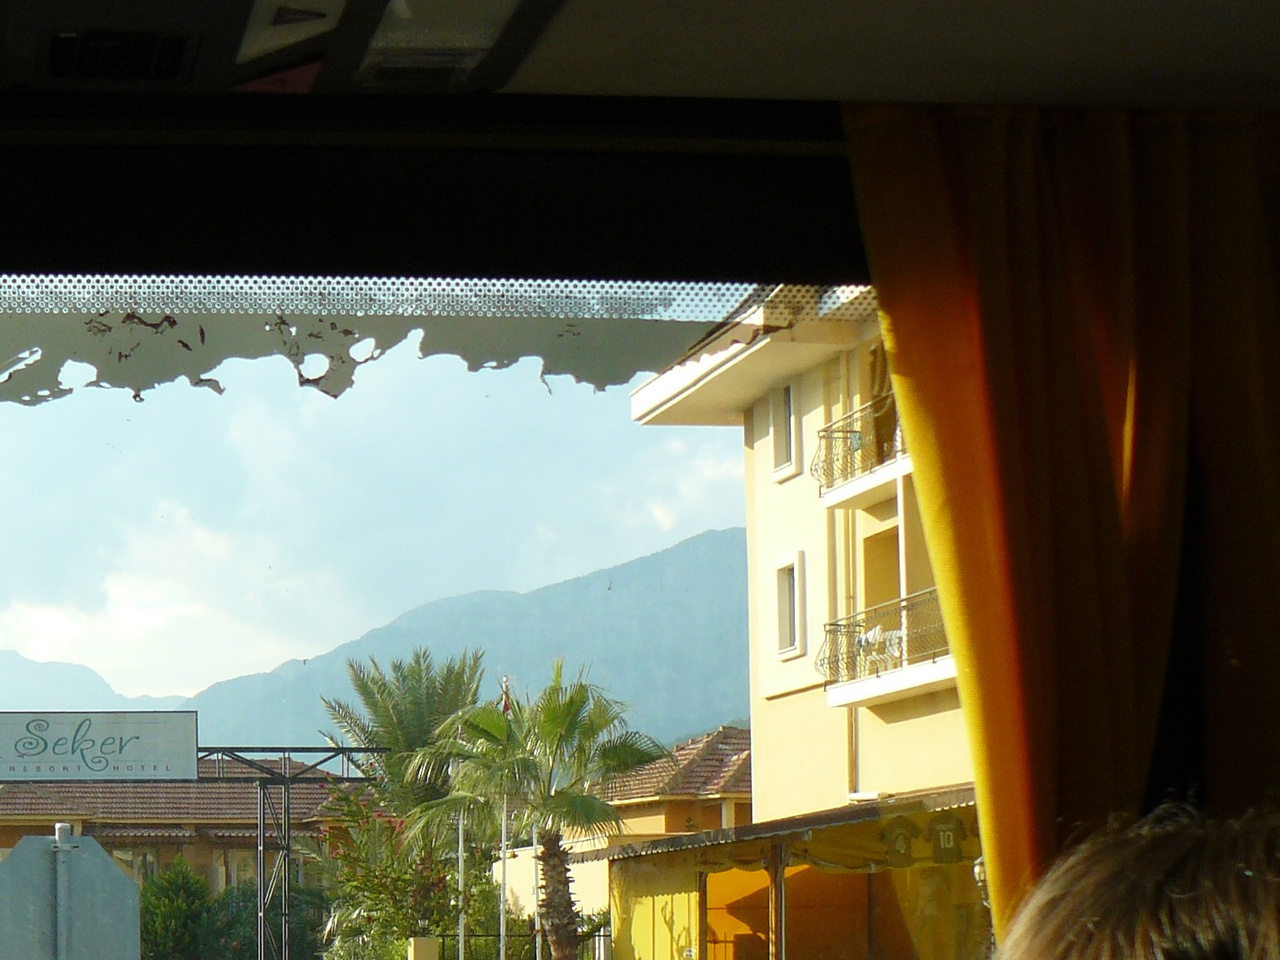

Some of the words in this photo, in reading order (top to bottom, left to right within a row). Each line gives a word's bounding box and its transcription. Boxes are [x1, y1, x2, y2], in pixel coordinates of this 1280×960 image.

[14, 718, 140, 772] Seker
[9, 765, 81, 773] RESORT
[113, 764, 171, 772] HOTEL
[939, 831, 954, 849] 10
